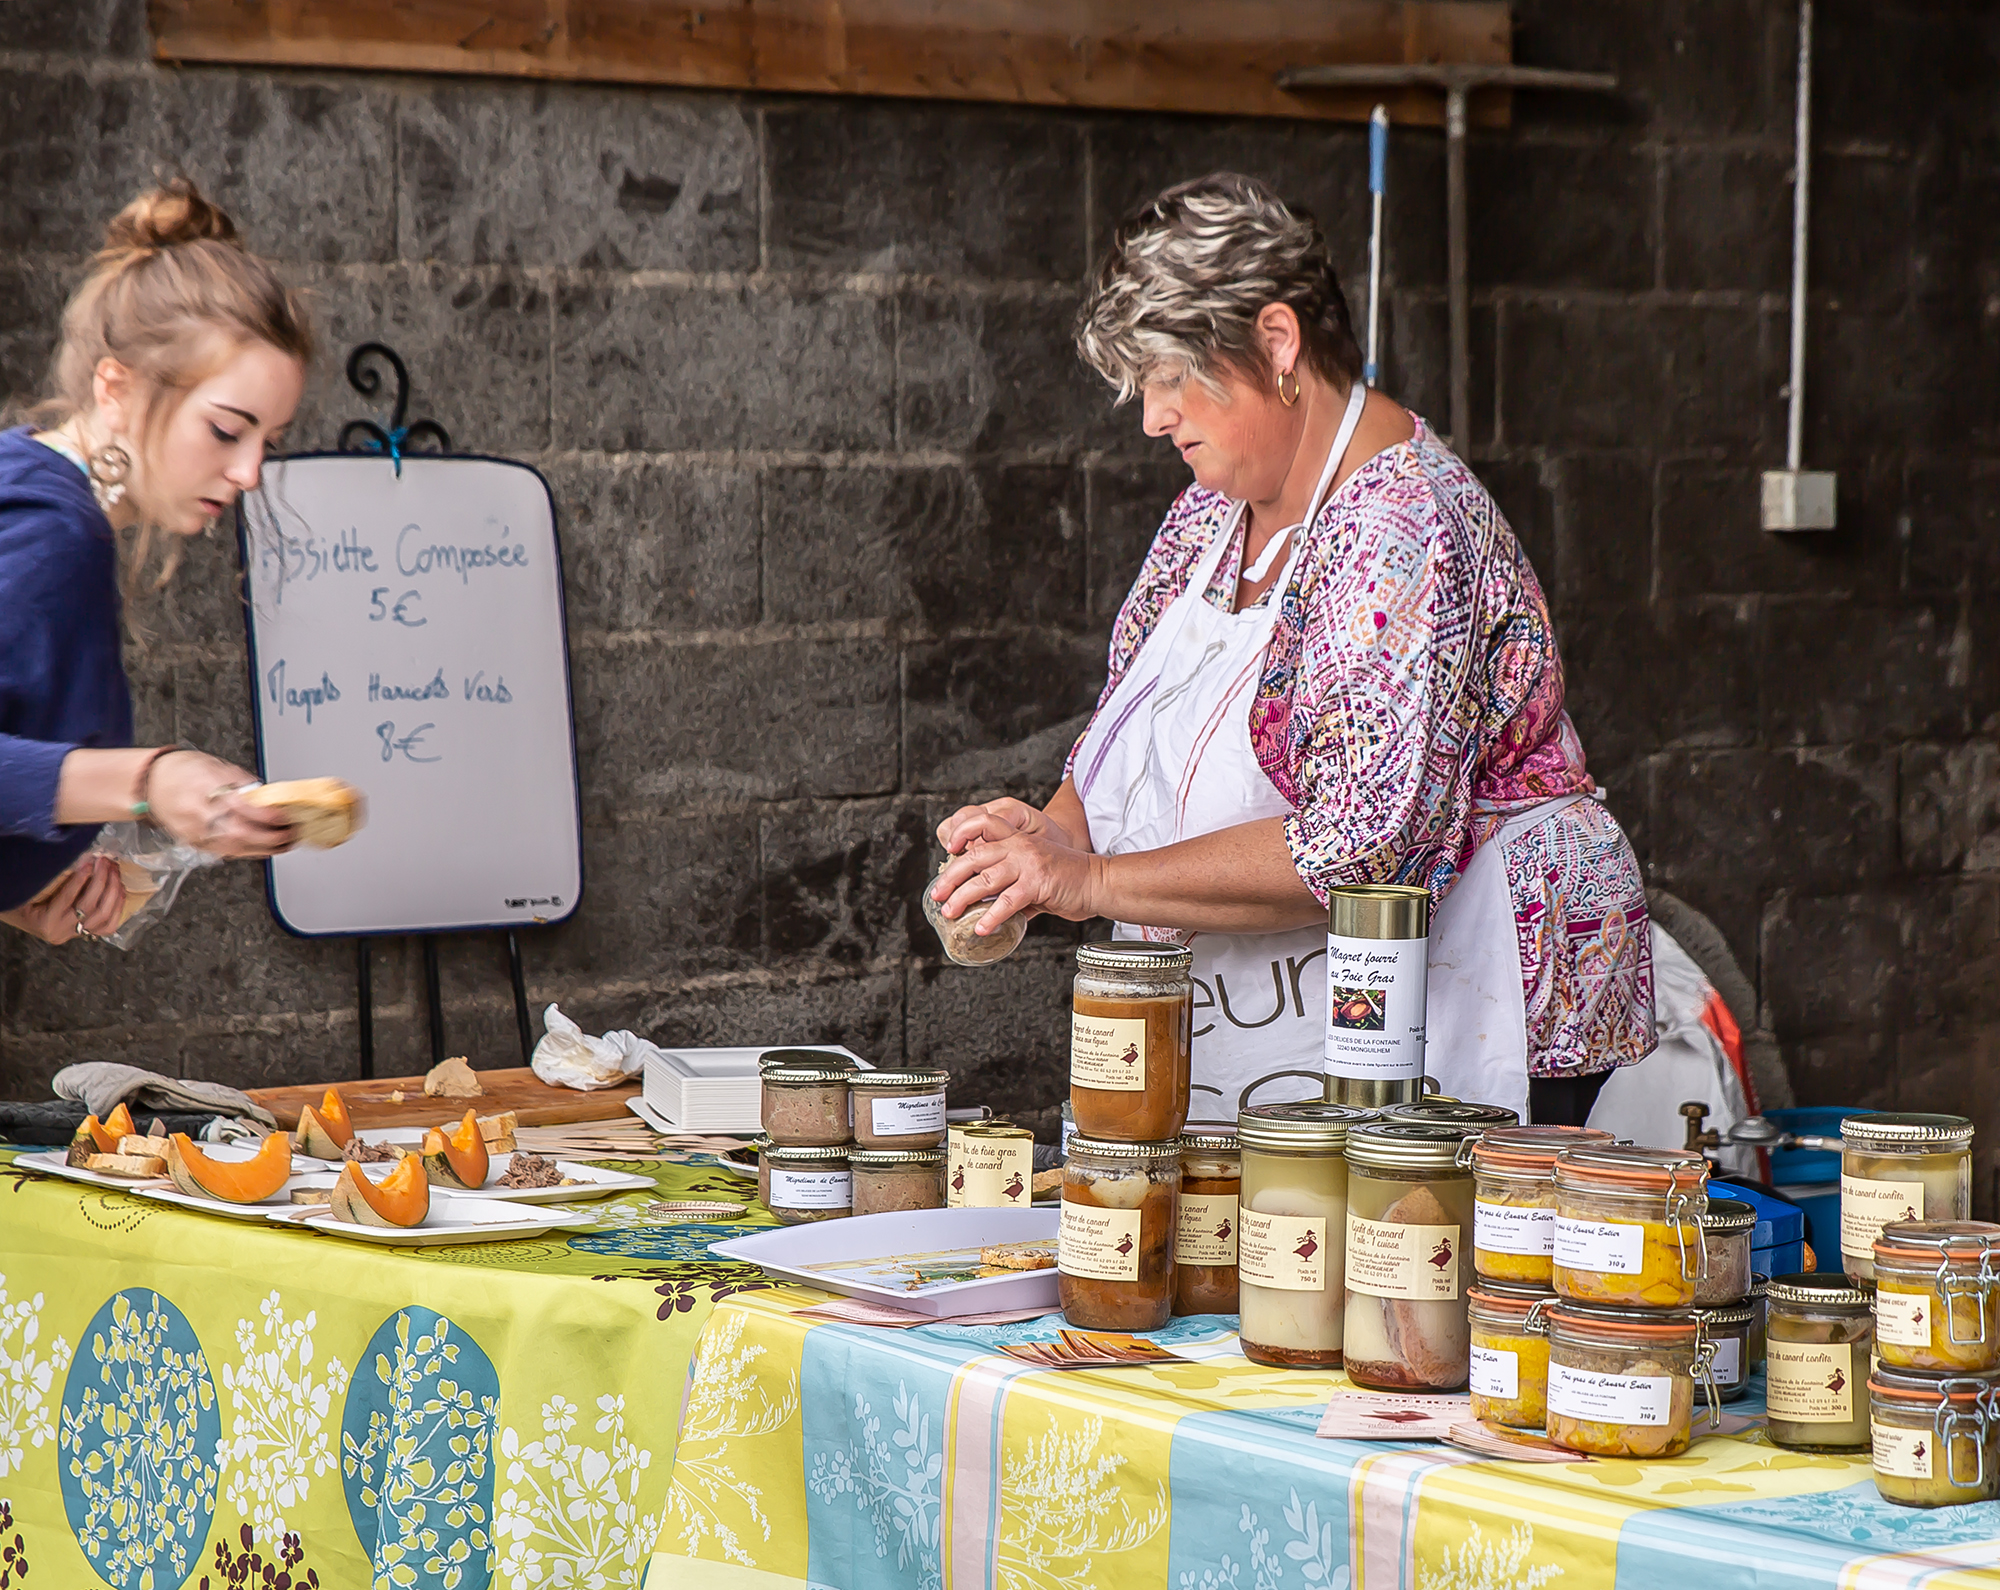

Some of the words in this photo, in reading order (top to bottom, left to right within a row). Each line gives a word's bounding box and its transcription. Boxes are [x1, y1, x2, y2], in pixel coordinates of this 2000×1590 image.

[396, 523, 529, 585] Composée
[369, 587, 427, 627] 5€
[368, 667, 450, 702] Haricots
[464, 670, 513, 704] Verts
[376, 720, 442, 763] 8€
[1330, 945, 1363, 964] Magret
[1364, 951, 1399, 967] fourré
[1331, 970, 1340, 979] au
[1341, 968, 1363, 983] Foie
[1367, 970, 1395, 987] Gras
[1092, 1028, 1115, 1037] canard
[1092, 1036, 1109, 1048] figues
[1350, 1045, 1391, 1054] MONGUILHEM
[971, 1144, 979, 1155] de
[980, 1144, 995, 1156] foie
[997, 1149, 1017, 1161] gras
[967, 1158, 974, 1169] de
[975, 1160, 1003, 1170] canard
[828, 1175, 850, 1185] Canard
[1855, 1188, 1877, 1199] canard
[1878, 1190, 1904, 1200] confits
[1184, 1204, 1209, 1213] canard
[1184, 1213, 1202, 1224] figues
[1503, 1210, 1529, 1220] Canard
[1531, 1212, 1554, 1221] Entier
[1086, 1218, 1110, 1227] canard
[1250, 1219, 1272, 1230] canard
[1086, 1226, 1103, 1237] figues
[1251, 1228, 1267, 1240] cuisse
[1367, 1225, 1374, 1236] de
[1376, 1228, 1405, 1239] canard
[1572, 1224, 1595, 1234] Canard
[1598, 1227, 1620, 1237] Entier
[1377, 1239, 1399, 1249] cuisse
[1482, 1352, 1498, 1362] Entier
[1782, 1352, 1804, 1362] canard
[1806, 1352, 1832, 1363] confits
[1588, 1377, 1596, 1385] de
[1598, 1377, 1627, 1388] Canard
[1629, 1380, 1652, 1390] Entier
